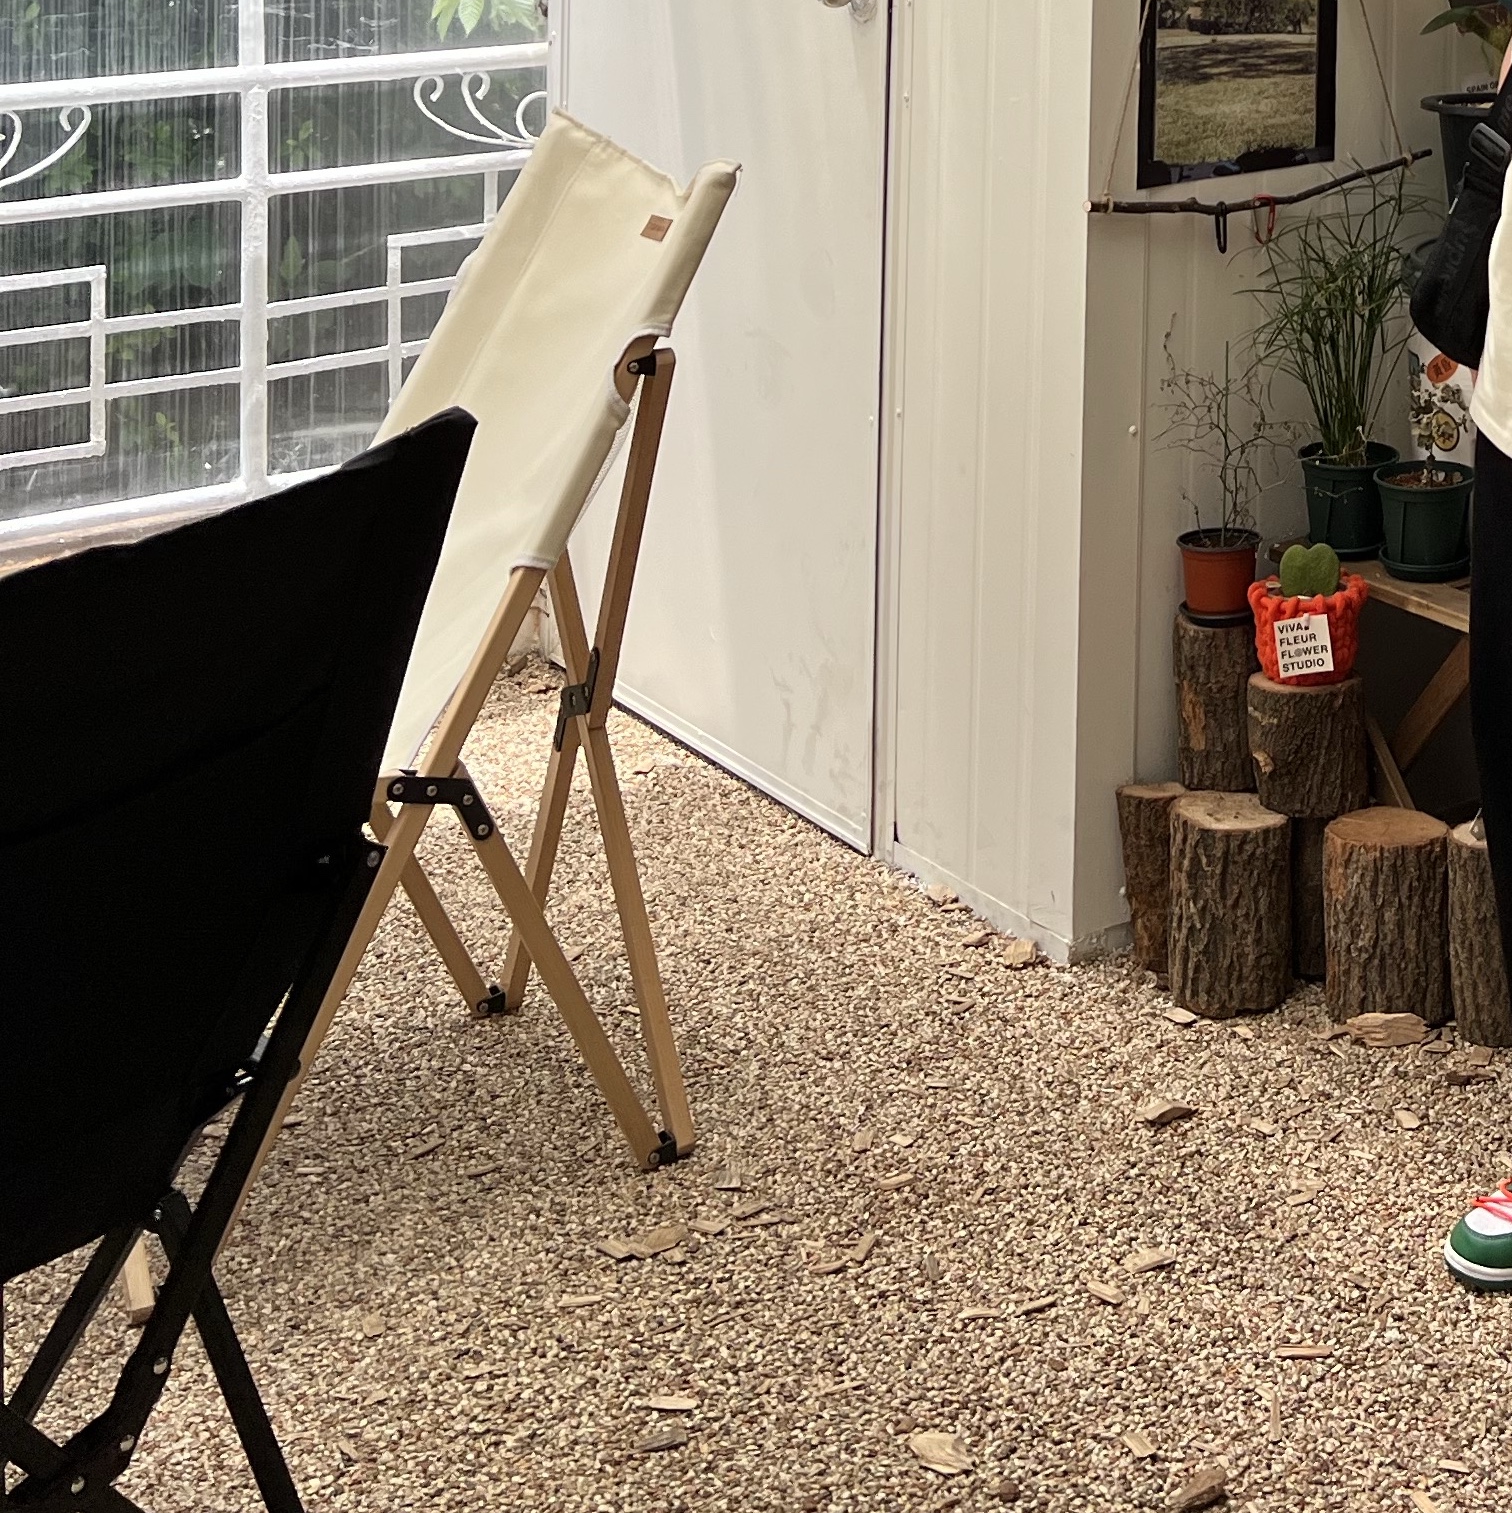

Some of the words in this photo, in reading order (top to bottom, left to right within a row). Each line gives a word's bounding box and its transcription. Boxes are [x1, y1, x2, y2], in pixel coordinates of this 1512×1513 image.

[1280, 633, 1317, 647] FLEUR
[1281, 644, 1329, 659] FLOWER
[1282, 658, 1325, 672] STUDIO
